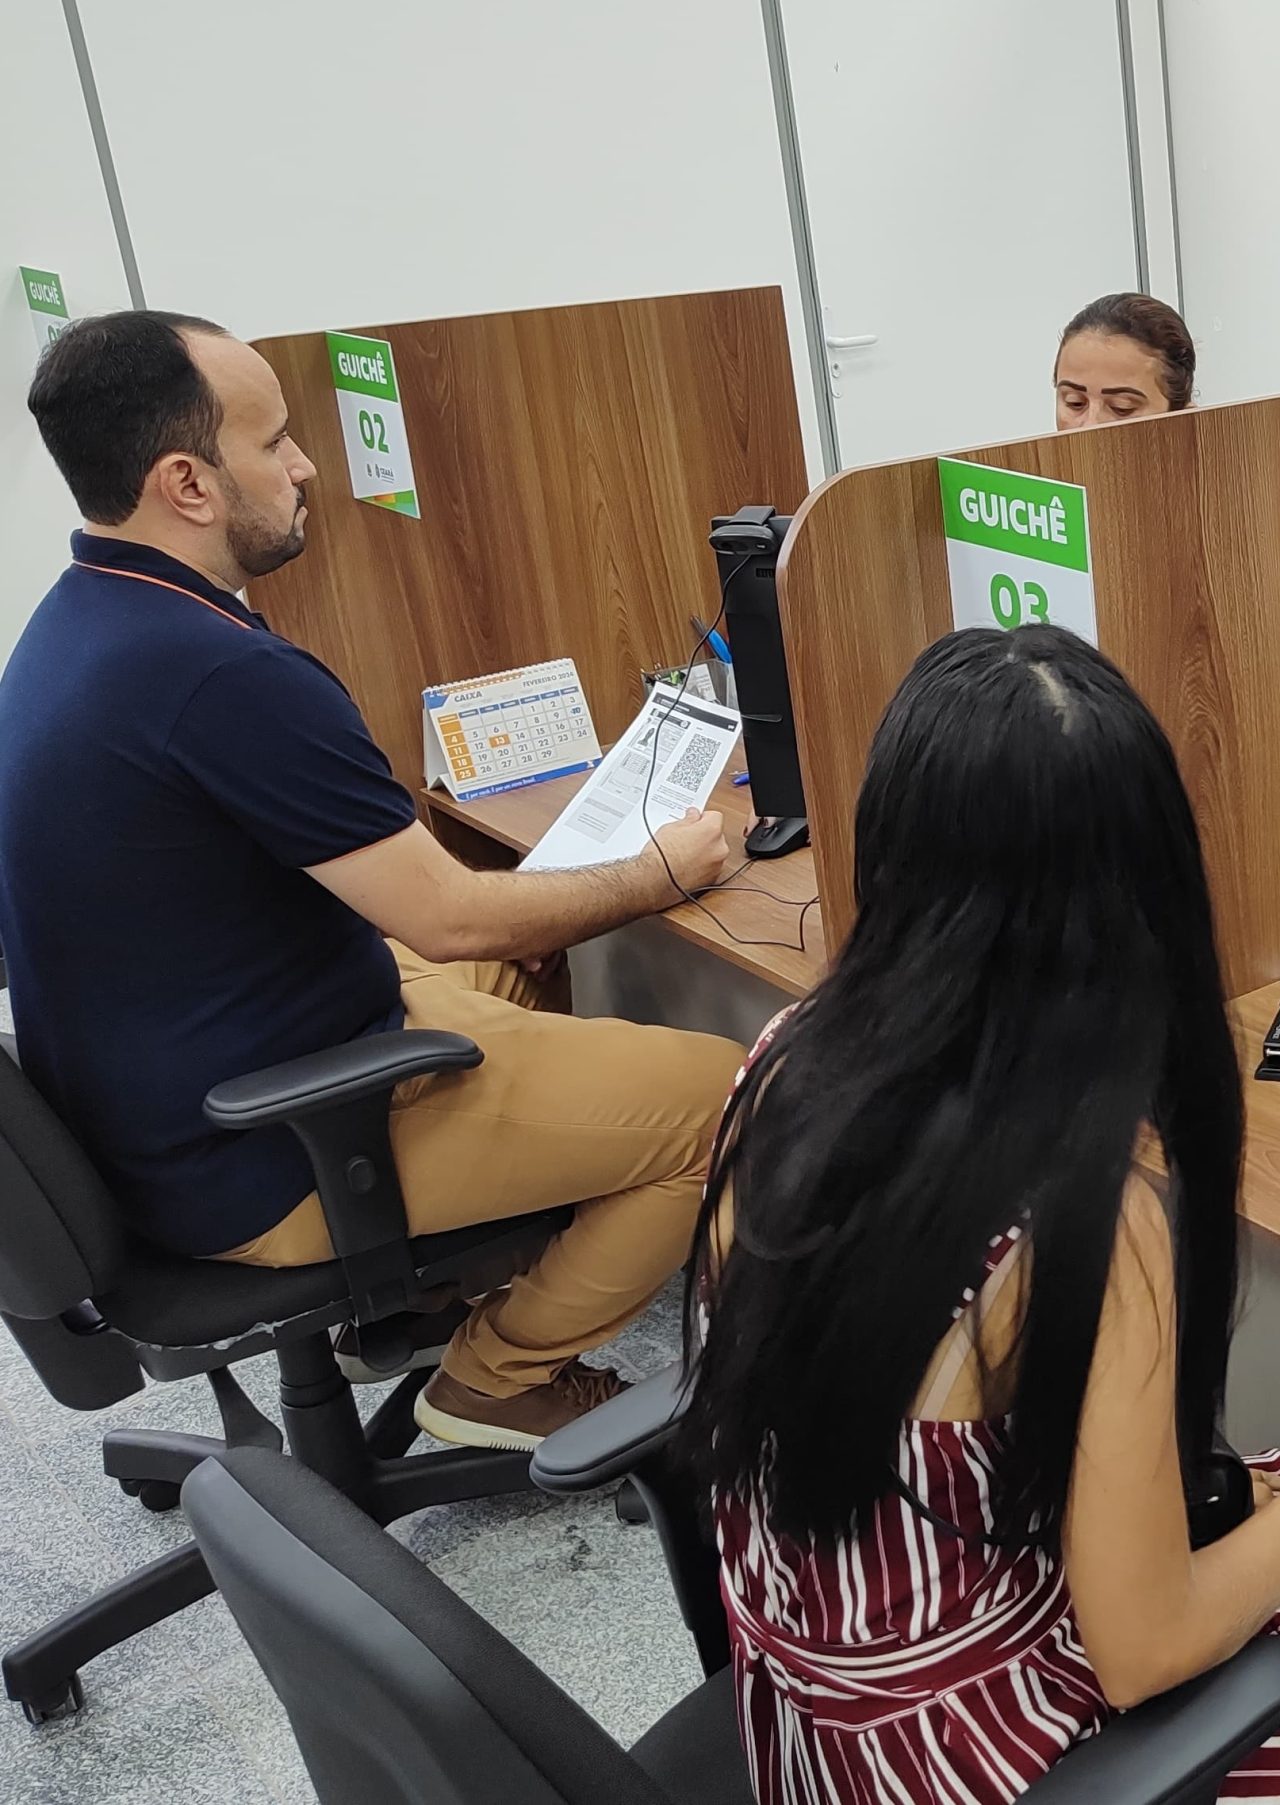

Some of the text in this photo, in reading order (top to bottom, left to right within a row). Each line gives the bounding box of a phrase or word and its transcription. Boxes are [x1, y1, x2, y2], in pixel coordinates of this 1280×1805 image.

[29, 281, 61, 306] GUICHÊ
[47, 325, 62, 345] 0
[337, 351, 388, 385] GUICHÊ
[358, 409, 390, 454] 02
[959, 488, 1068, 545] GUICHÊ
[989, 572, 1051, 630] 03
[454, 691, 482, 702] CAIXA
[457, 759, 467, 767] 18
[498, 749, 509, 757] 20
[538, 739, 549, 747] 22
[558, 734, 568, 742] 23
[495, 736, 505, 744] 13
[460, 770, 471, 778] 25
[522, 755, 532, 763] 28
